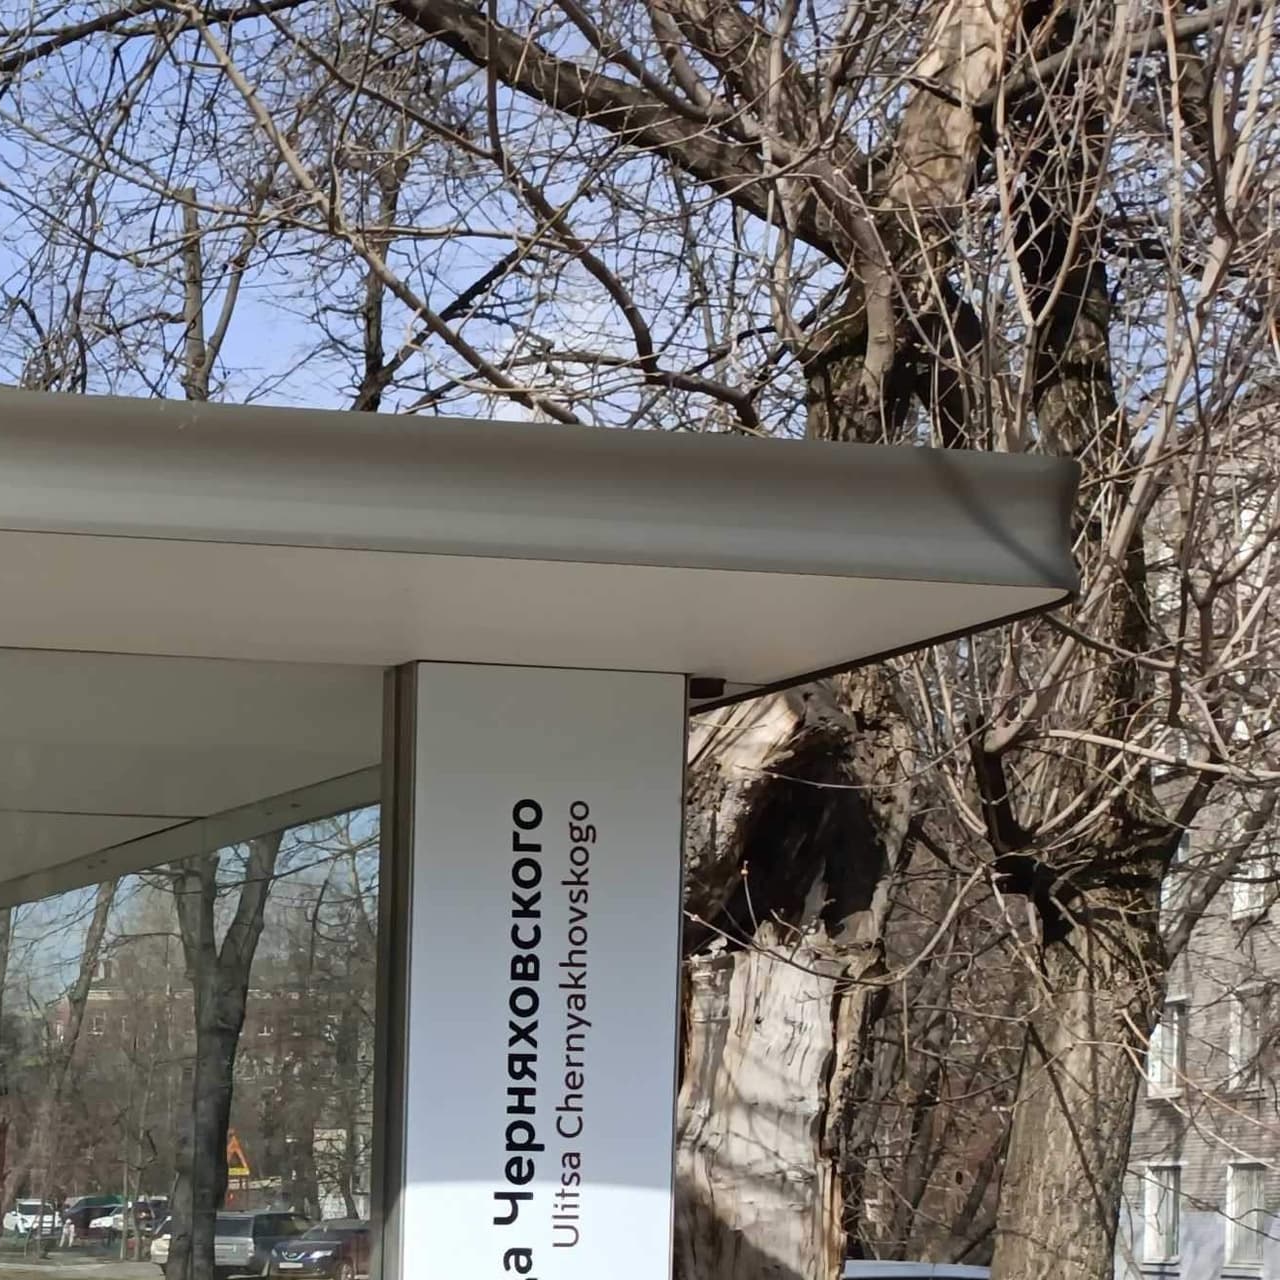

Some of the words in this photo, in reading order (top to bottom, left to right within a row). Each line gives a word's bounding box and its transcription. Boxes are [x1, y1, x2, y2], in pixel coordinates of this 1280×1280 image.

[493, 798, 545, 1225] Черняховского
[556, 799, 597, 1139] Chernyakhovskogo
[552, 1152, 581, 1248] Ulitsa
